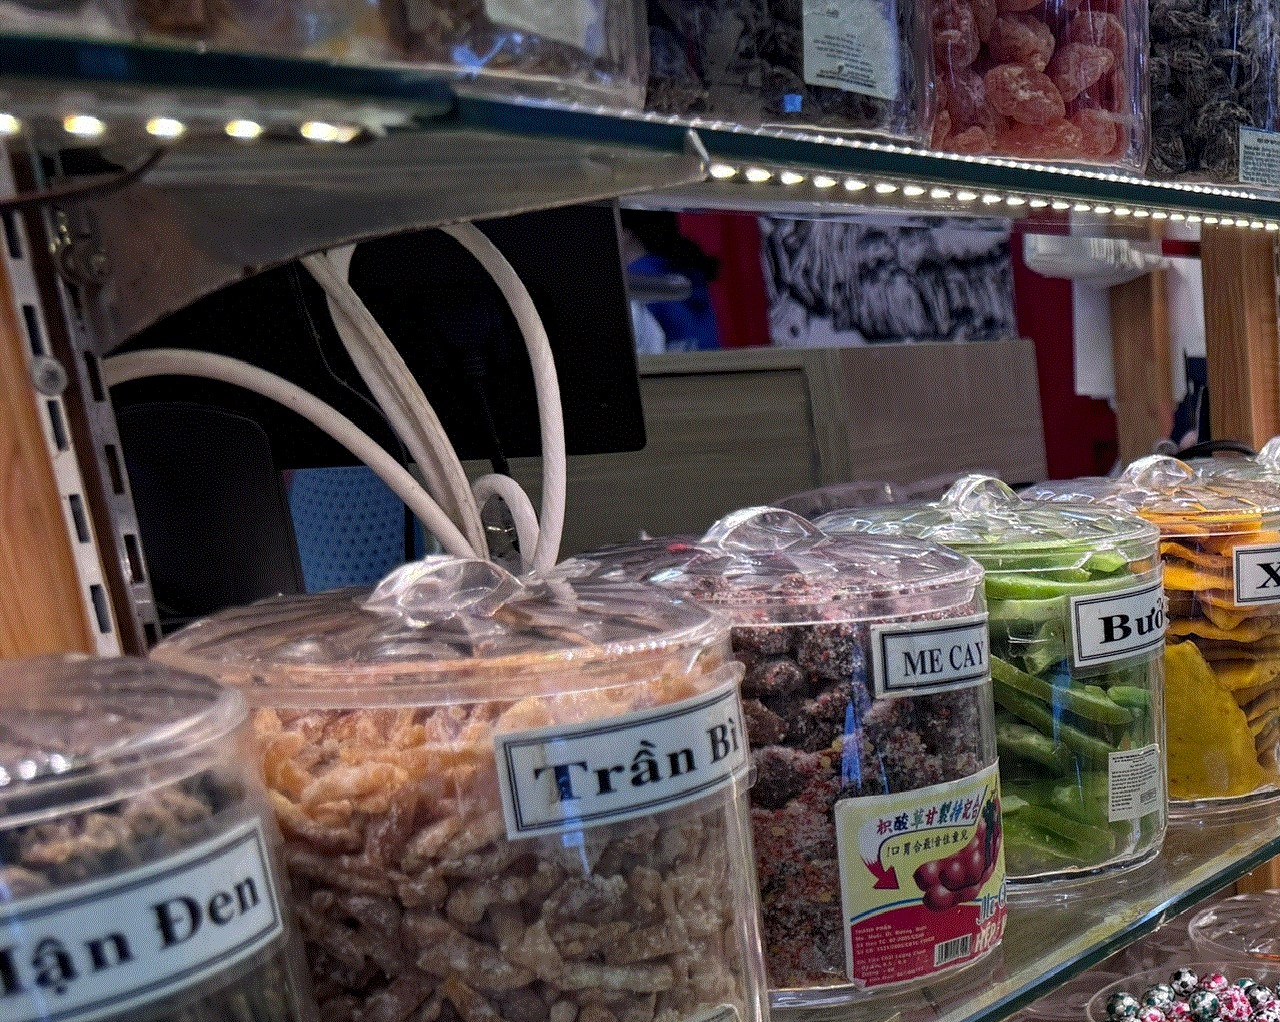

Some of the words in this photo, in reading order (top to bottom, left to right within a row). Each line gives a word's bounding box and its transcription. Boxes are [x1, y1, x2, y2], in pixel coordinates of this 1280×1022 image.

[903, 646, 944, 676] ME
[948, 641, 987, 671] CAY
[533, 738, 698, 803] Trần
[707, 718, 741, 765] Bì
[150, 877, 259, 950] Đen
